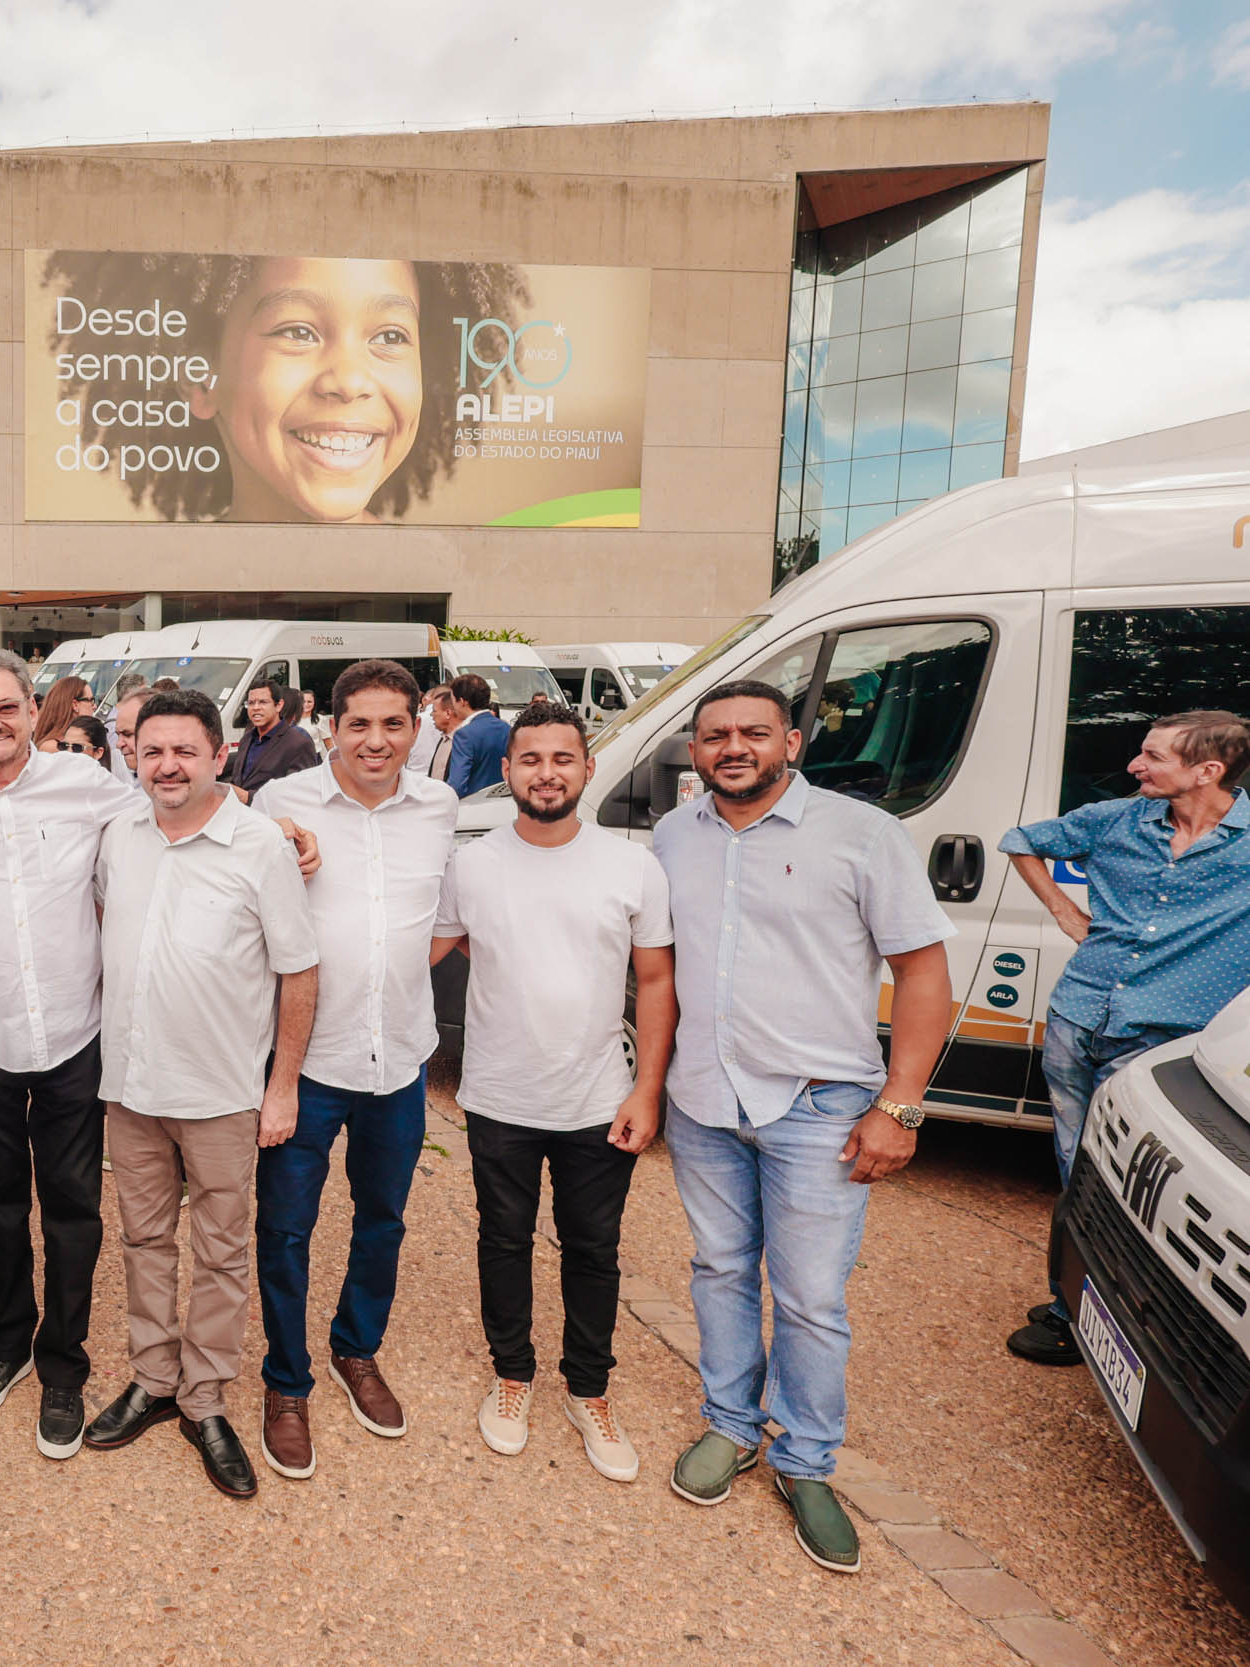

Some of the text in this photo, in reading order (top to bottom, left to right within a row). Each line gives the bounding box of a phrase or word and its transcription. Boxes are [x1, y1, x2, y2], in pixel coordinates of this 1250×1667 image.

[56, 296, 187, 337] Desde
[453, 317, 573, 390] 190
[523, 348, 558, 361] ANOS
[56, 353, 218, 390] sempre,
[56, 399, 190, 427] a casa
[456, 393, 555, 424] ALEPI
[455, 427, 623, 443] ASSEMBLEIA LEGISLATIVA
[56, 433, 220, 480] do povo
[454, 445, 477, 457] DO
[481, 445, 536, 458] ESTADO
[540, 446, 562, 459] DO
[994, 960, 1024, 970] DIESEL
[990, 991, 1014, 1001] ARLA
[1122, 1131, 1184, 1233] FIAT
